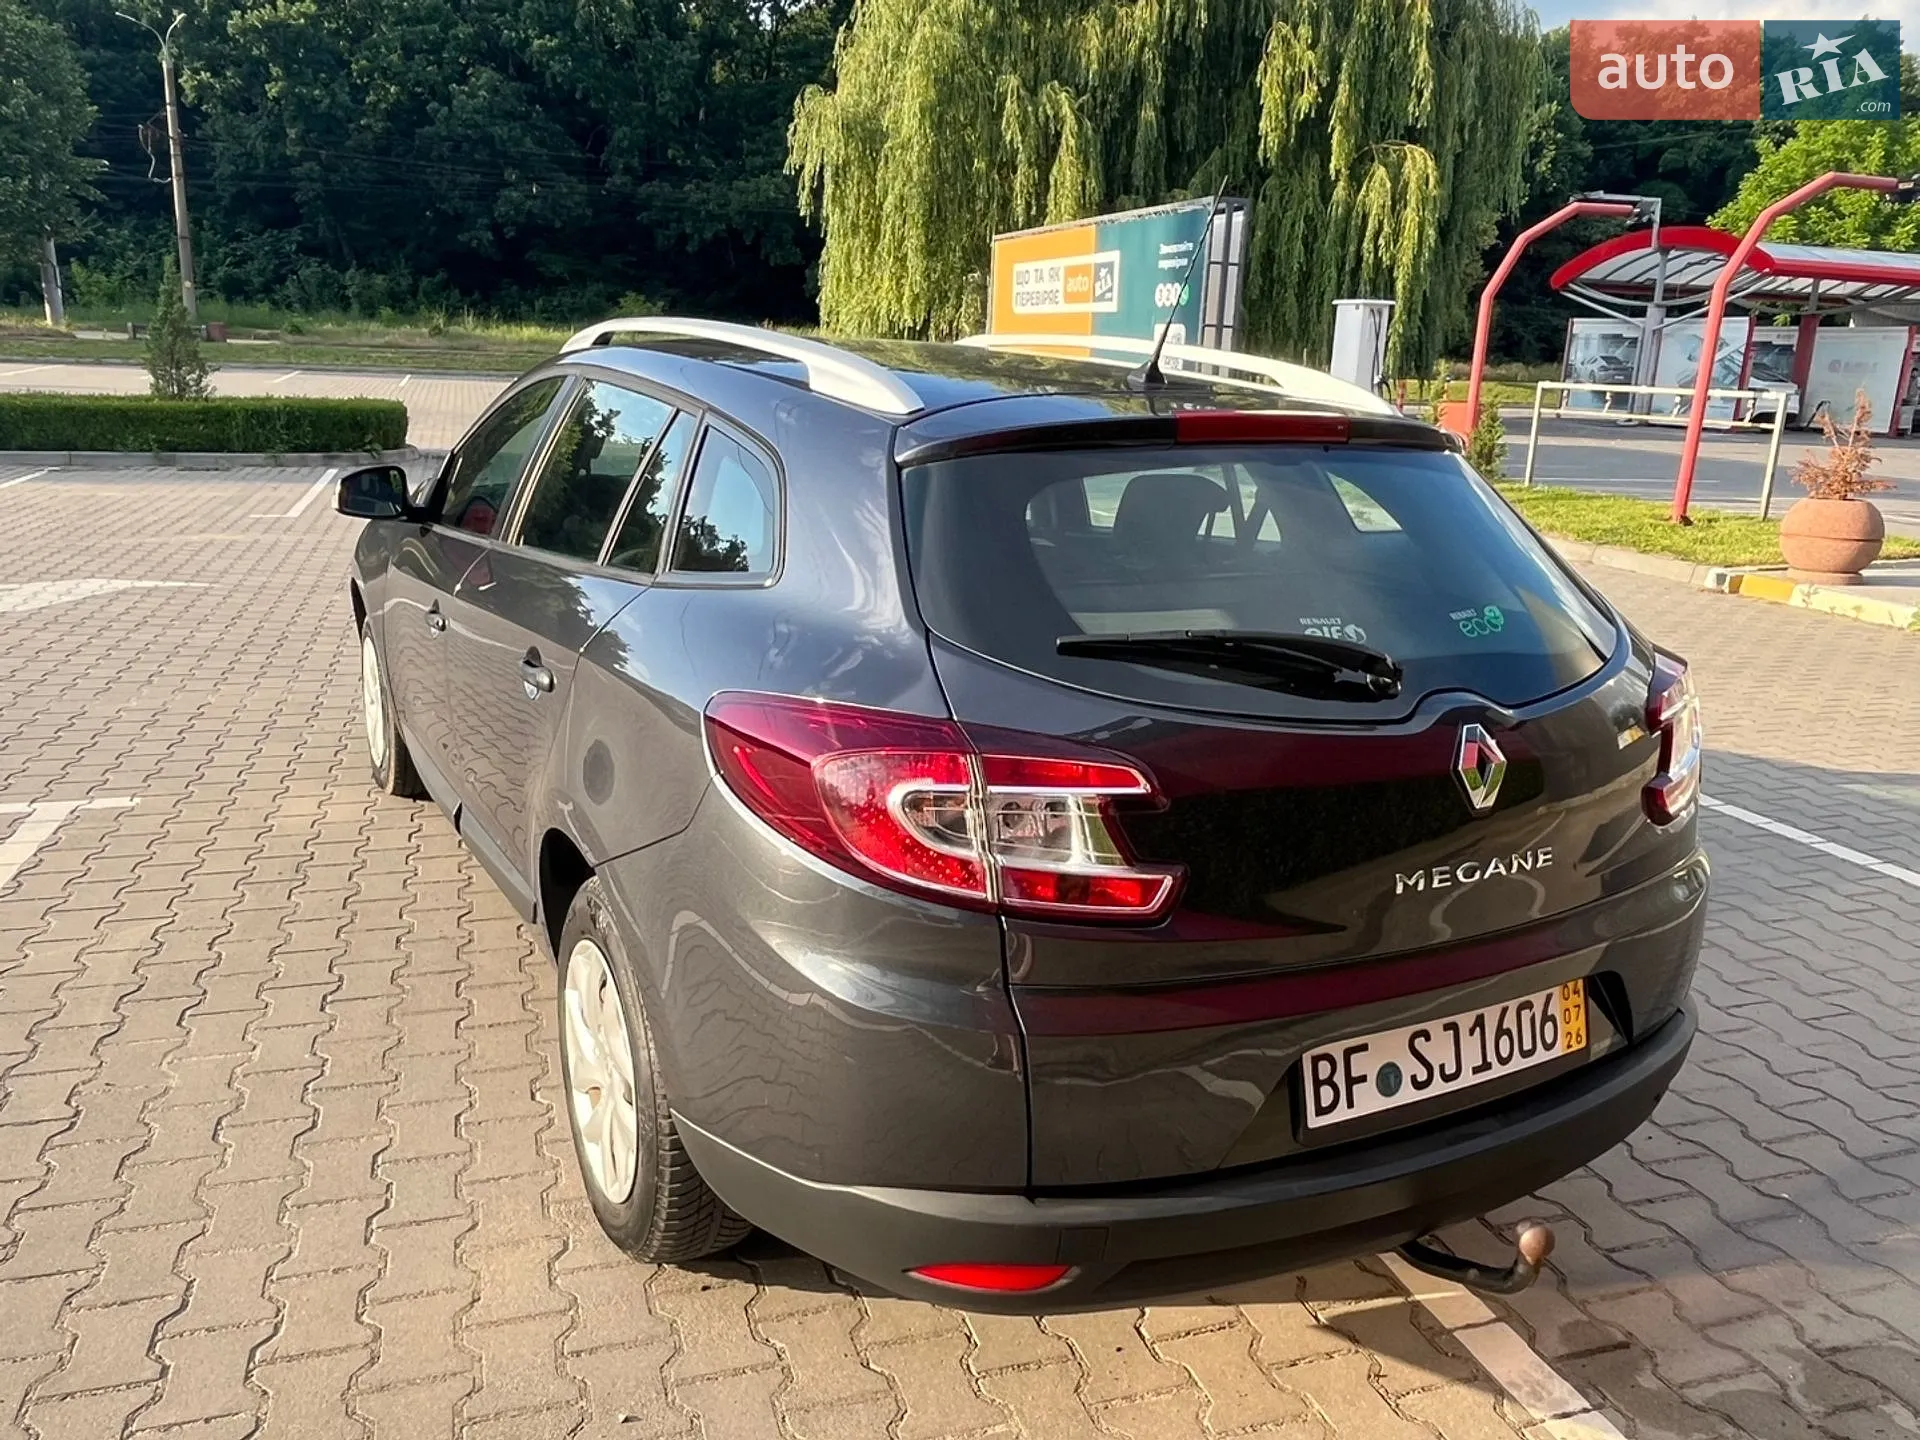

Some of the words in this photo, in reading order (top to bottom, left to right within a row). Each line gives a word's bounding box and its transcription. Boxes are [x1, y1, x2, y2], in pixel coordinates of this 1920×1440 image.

[1016, 269, 1030, 287] ЩО
[1034, 268, 1044, 284] ТА
[1066, 273, 1089, 293] auto
[1299, 617, 1342, 625] RENAULT
[1395, 846, 1553, 895] MEGANE
[1561, 982, 1581, 1001] 04
[1563, 1004, 1582, 1025] 07
[1565, 1030, 1584, 1050] 26
[1310, 1042, 1369, 1118] BF
